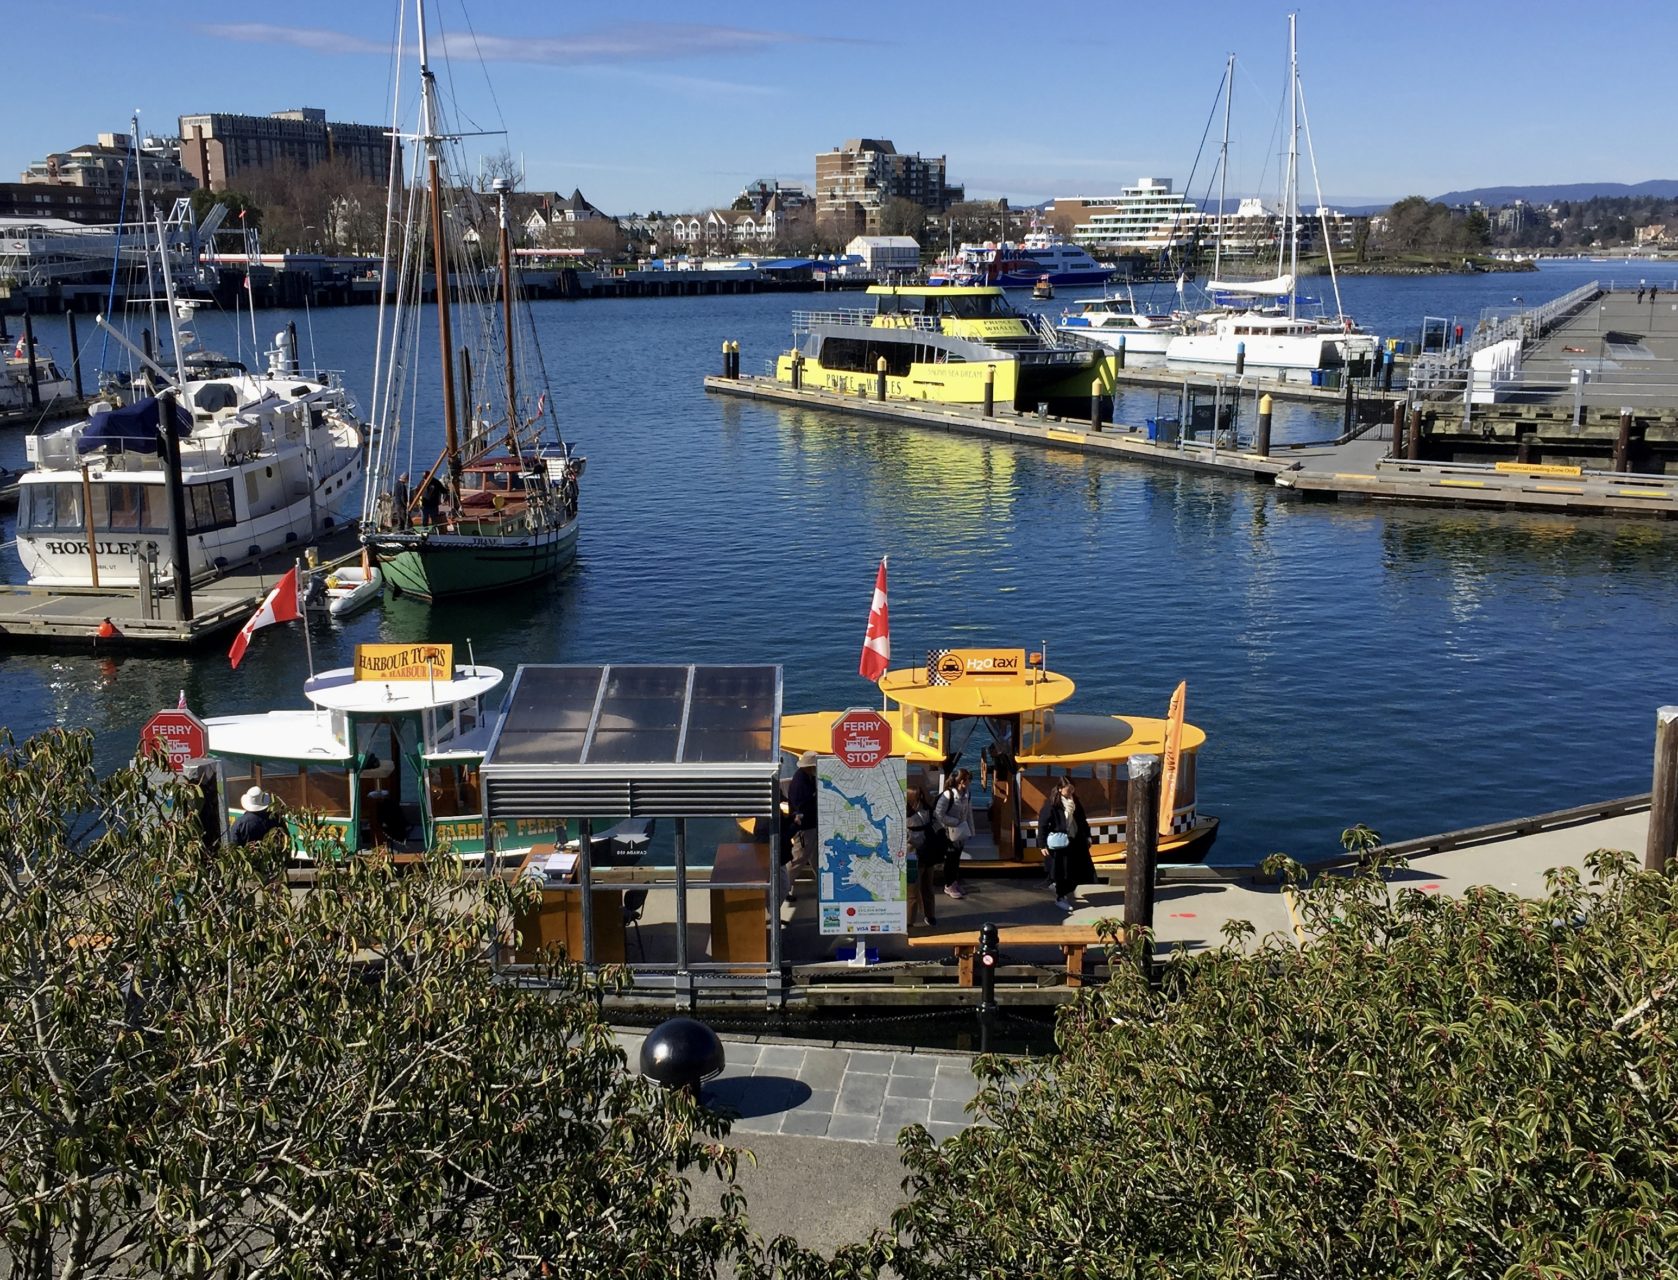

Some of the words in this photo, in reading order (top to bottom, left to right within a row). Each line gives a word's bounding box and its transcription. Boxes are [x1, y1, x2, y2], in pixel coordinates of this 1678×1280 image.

[866, 378, 902, 395] WHLES
[46, 542, 139, 555] HOKULE
[360, 651, 409, 671] HARBOUR
[411, 647, 446, 667] TORS
[389, 666, 427, 677] HARBOUR
[152, 725, 192, 735] FERRY
[843, 722, 880, 731] FERRY
[168, 754, 191, 763] TOP
[847, 753, 878, 763] STOP
[436, 821, 509, 841] HARBOR
